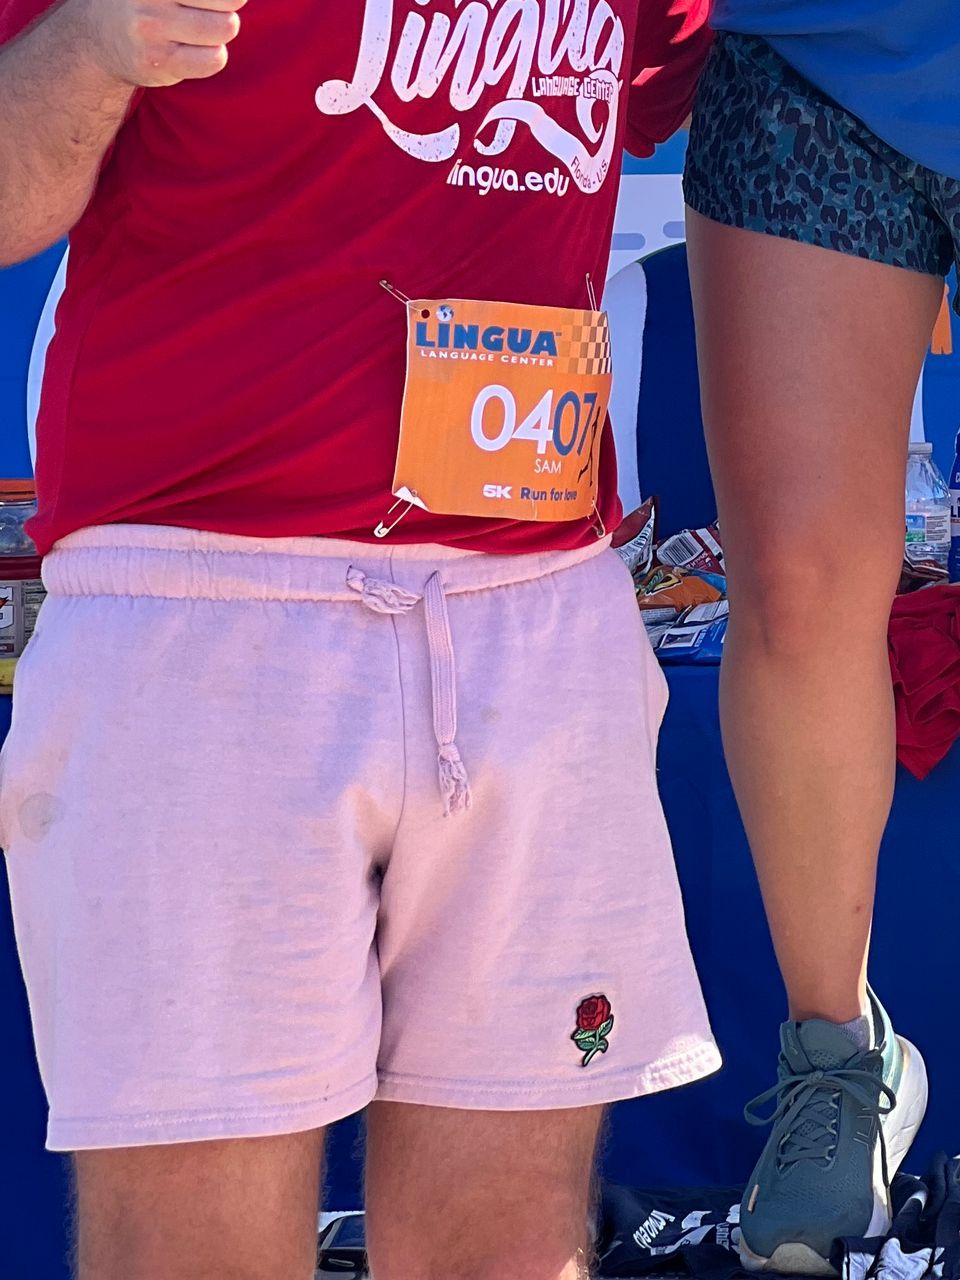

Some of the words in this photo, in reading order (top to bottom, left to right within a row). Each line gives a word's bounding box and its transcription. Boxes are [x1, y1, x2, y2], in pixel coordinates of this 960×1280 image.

[532, 76, 580, 97] LANGUAGE
[446, 159, 570, 196] lingua.edu
[416, 321, 558, 357] LINGUA
[421, 349, 494, 362] LANGUAGE
[501, 355, 553, 366] CENTER
[470, 384, 598, 456] 0407
[534, 458, 561, 474] SAM
[483, 484, 512, 499] 5K
[520, 487, 547, 500] Run
[550, 488, 563, 501] for
[564, 488, 577, 501] love
